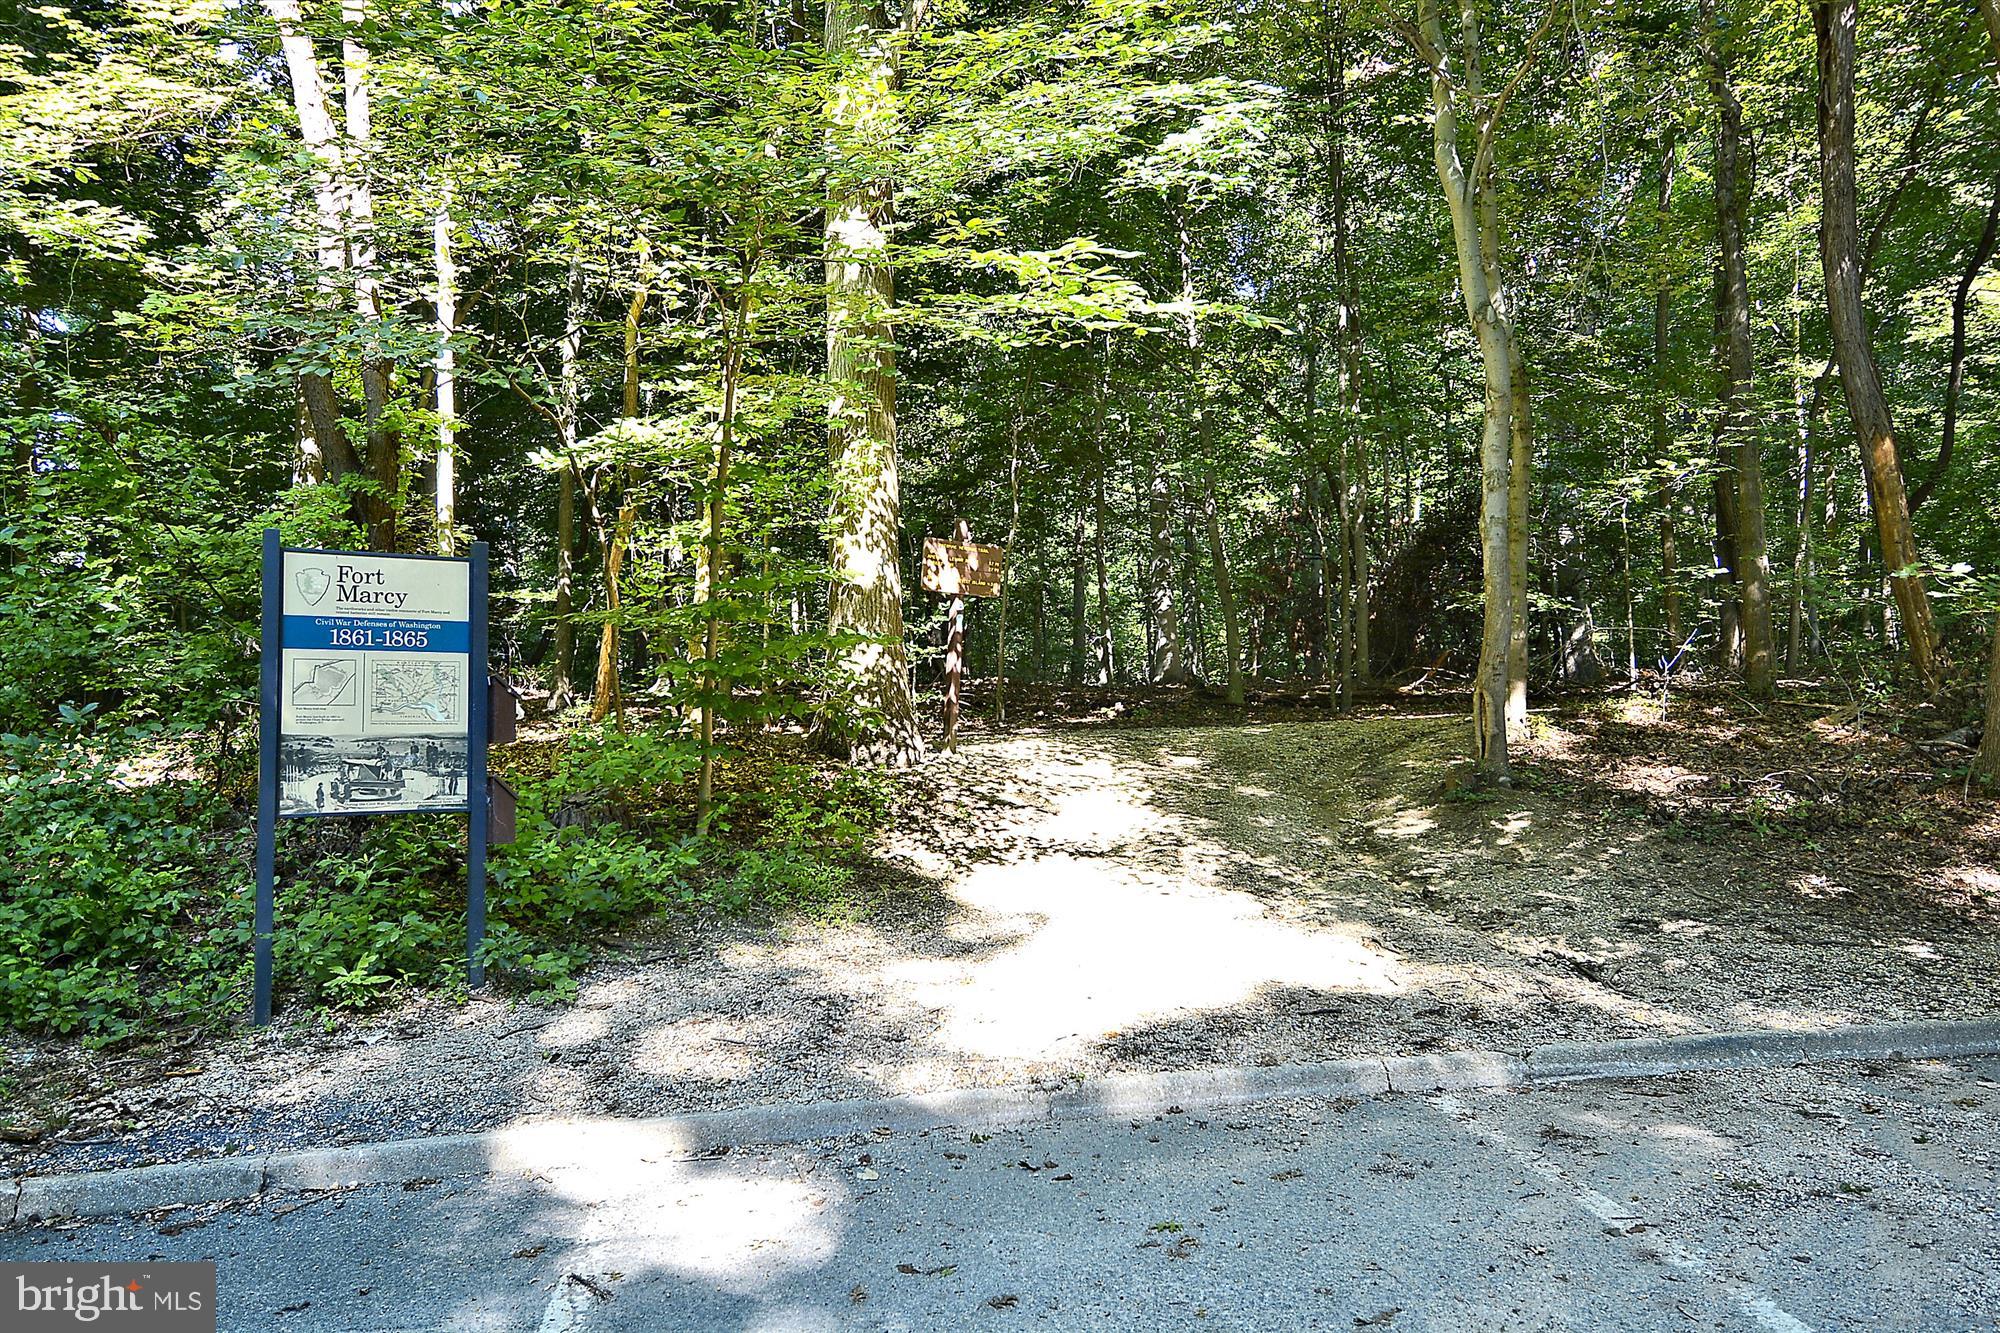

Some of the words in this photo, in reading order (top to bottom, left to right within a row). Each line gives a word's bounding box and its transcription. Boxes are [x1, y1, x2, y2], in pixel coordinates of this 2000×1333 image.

[336, 565, 385, 585] Fort
[336, 584, 408, 608] Marcy
[315, 618, 334, 626] Civil
[353, 620, 387, 628] Defenses
[398, 621, 441, 631] Washington
[330, 629, 428, 647] 1861-1865
